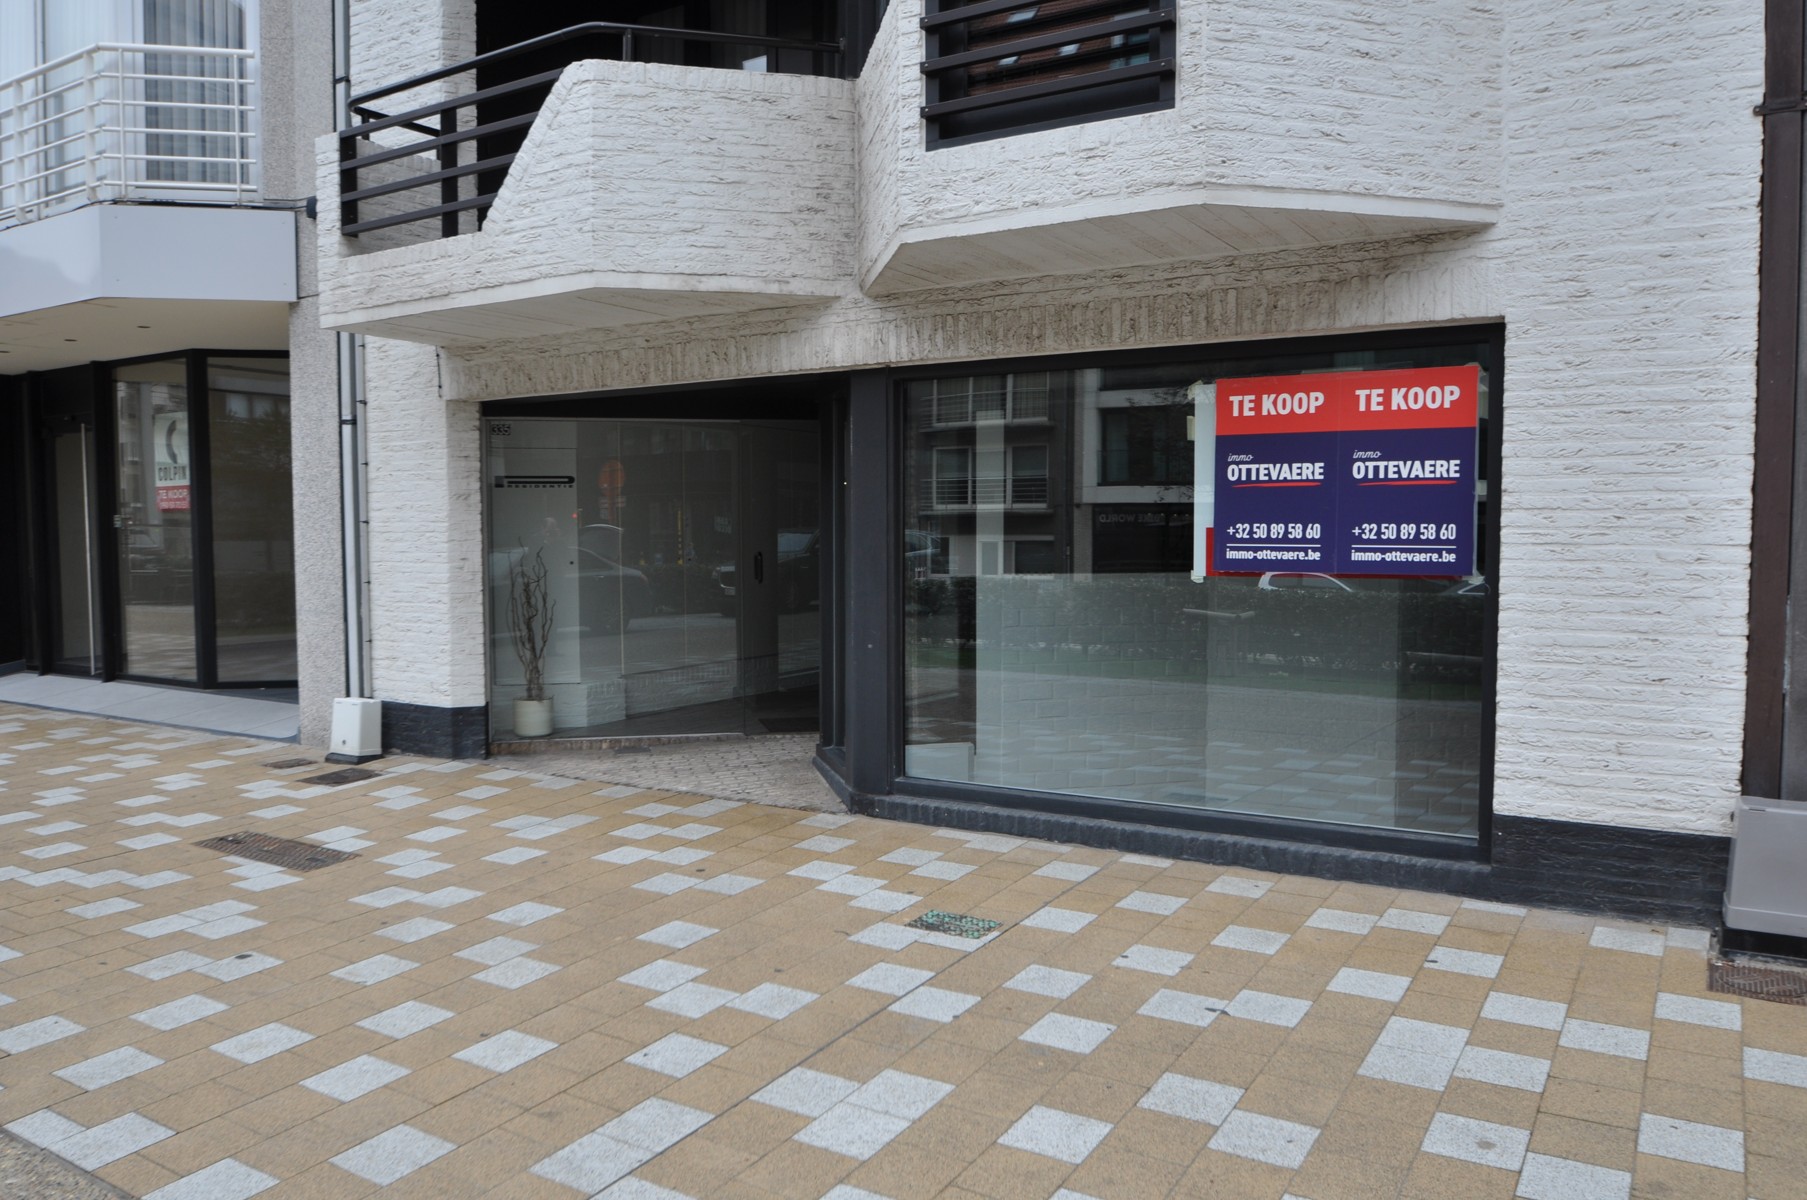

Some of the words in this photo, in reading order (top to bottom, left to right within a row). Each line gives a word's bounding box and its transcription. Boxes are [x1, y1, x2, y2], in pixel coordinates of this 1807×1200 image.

[1229, 395, 1256, 417] TE
[1261, 391, 1325, 416] KOOP
[1355, 389, 1384, 412] TE
[1391, 385, 1460, 411] KOOP
[1227, 453, 1254, 462] immo
[1352, 450, 1382, 459] immo
[158, 465, 187, 481] COLPIN
[1227, 462, 1325, 482] OTTEVAERE
[1352, 459, 1460, 479] OTTEVAERE
[1226, 523, 1250, 539] +32
[1252, 523, 1268, 539] 50
[1270, 523, 1286, 539] 89
[1287, 523, 1304, 539] 58
[1305, 523, 1321, 539] 60
[1351, 523, 1378, 540] +32
[1380, 523, 1397, 540] 50
[1400, 523, 1417, 540] 89
[1419, 523, 1437, 540] 58
[1439, 523, 1457, 540] 60
[1226, 548, 1321, 561] immo-ottevaere.be
[1351, 549, 1456, 563] immo-ottevaere.be
